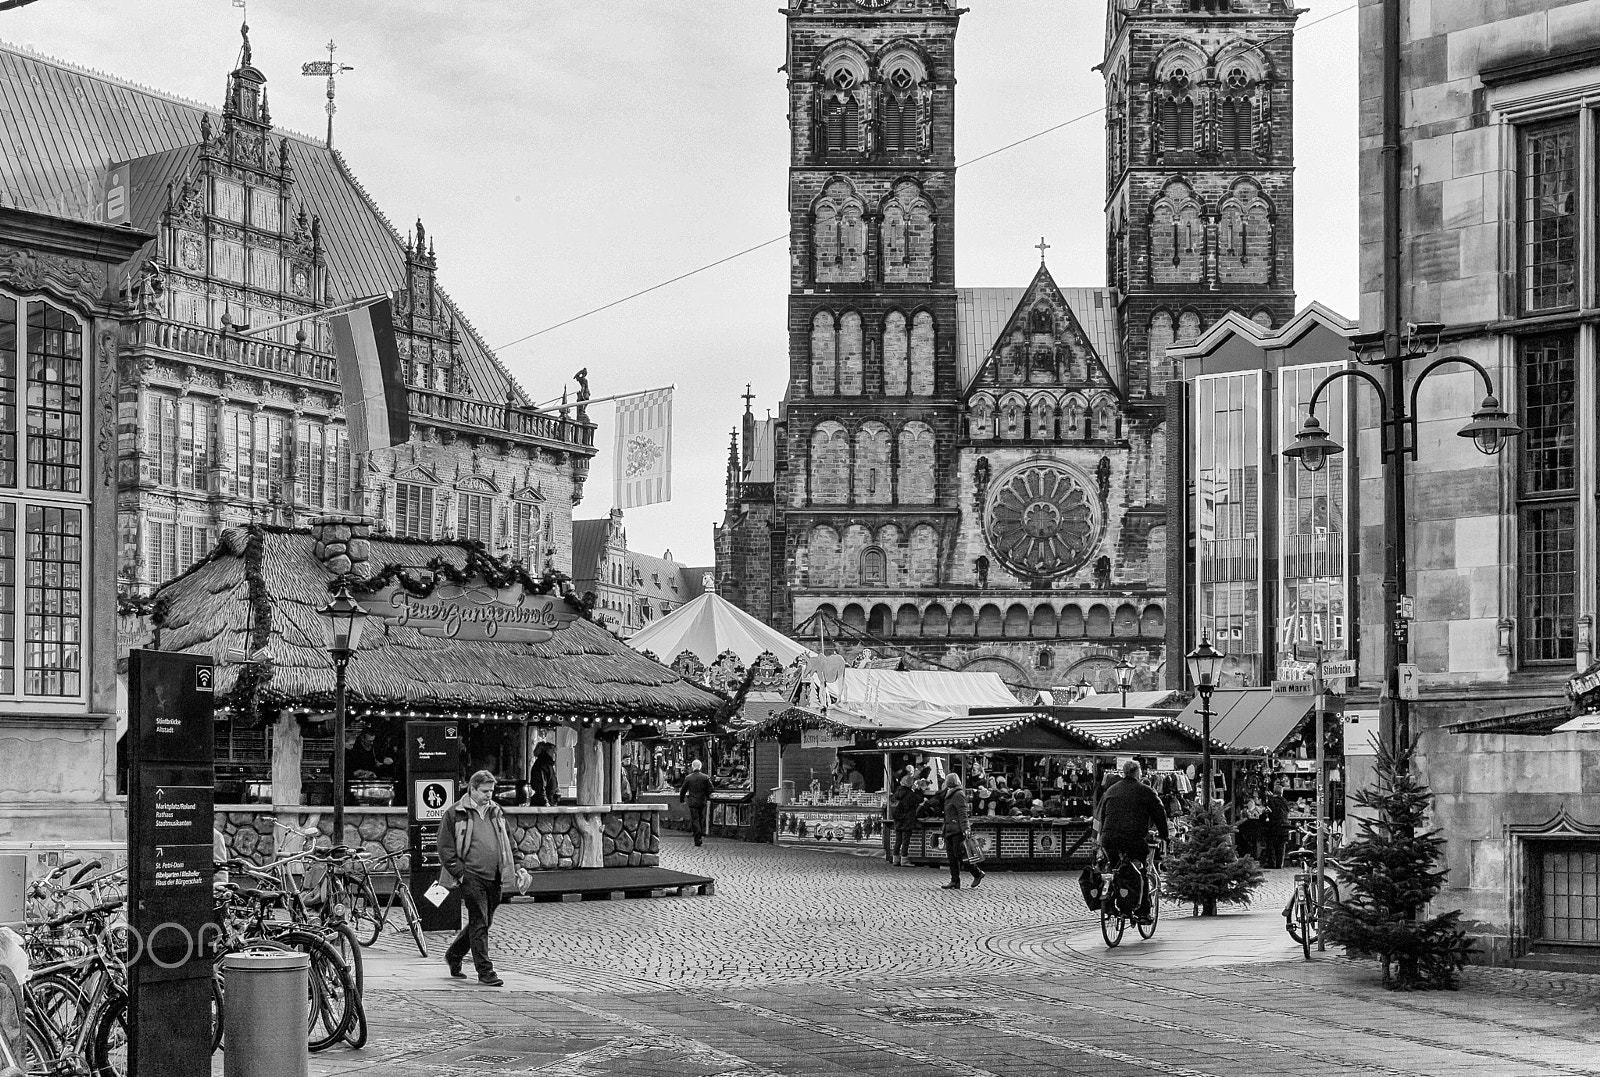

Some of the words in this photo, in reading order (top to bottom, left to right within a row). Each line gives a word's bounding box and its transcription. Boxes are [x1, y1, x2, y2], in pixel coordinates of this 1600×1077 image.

[389, 589, 559, 638] Feuerzangenbowle
[1323, 663, 1352, 676] Stintbrücke
[1275, 685, 1287, 693] Am
[1288, 684, 1311, 693] Markt
